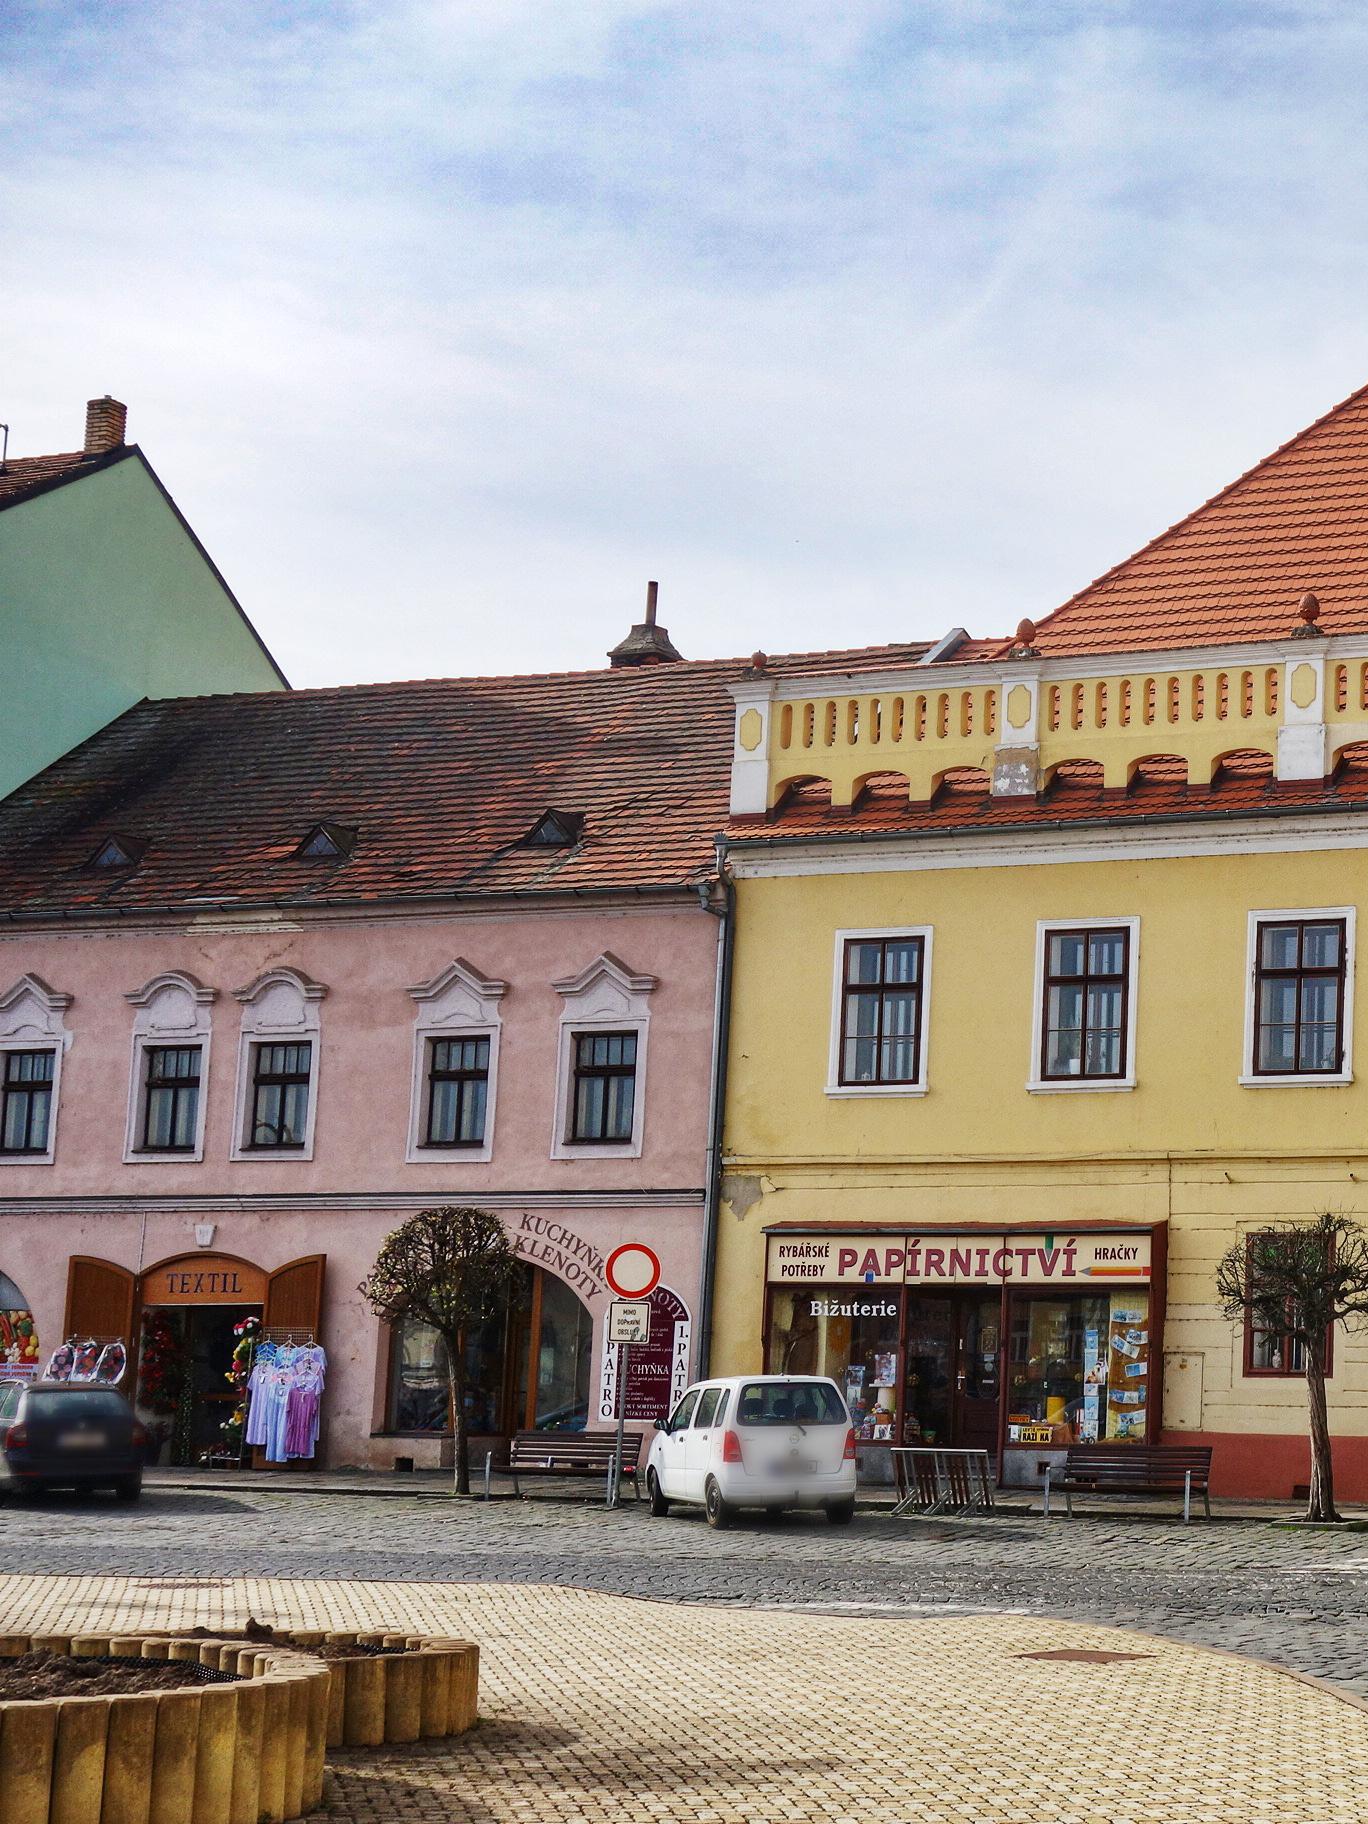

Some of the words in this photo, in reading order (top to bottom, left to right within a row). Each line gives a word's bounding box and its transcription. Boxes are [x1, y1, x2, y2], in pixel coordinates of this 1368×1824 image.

[778, 1242, 830, 1258] RYBÁŘSKÉ
[837, 1238, 1078, 1277] PAPÍRNICTVÍ
[1094, 1244, 1138, 1260] HRAČKY
[514, 1233, 602, 1300] KLENOTY
[781, 1261, 826, 1277] POTŘEBY
[166, 1272, 242, 1294] TEXTIL
[809, 1299, 897, 1317] Bižuterie
[679, 1325, 689, 1338] 1.
[628, 1362, 670, 1375] CHYŇKA
[601, 1342, 616, 1417] PATRO
